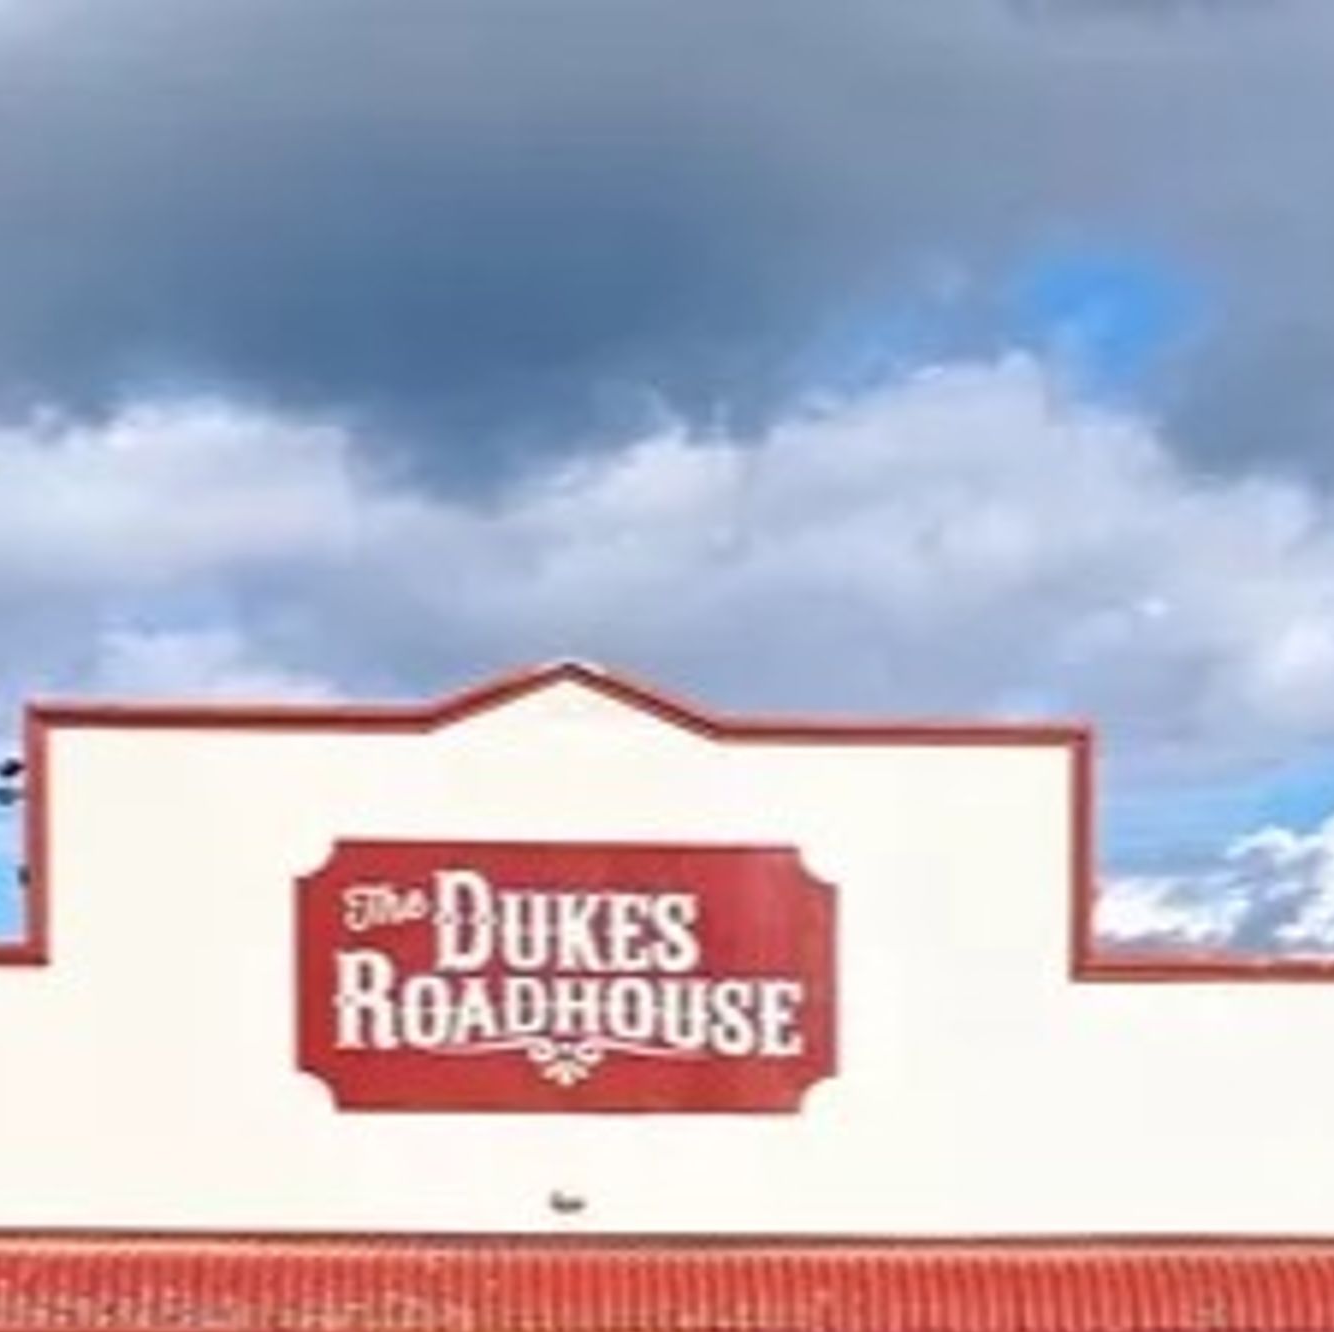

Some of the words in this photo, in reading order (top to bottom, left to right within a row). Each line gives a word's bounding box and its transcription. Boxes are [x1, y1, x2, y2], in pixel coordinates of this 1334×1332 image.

[342, 883, 429, 932] The
[433, 869, 700, 973] DUKES
[334, 949, 803, 1057] ROADHOUSE
